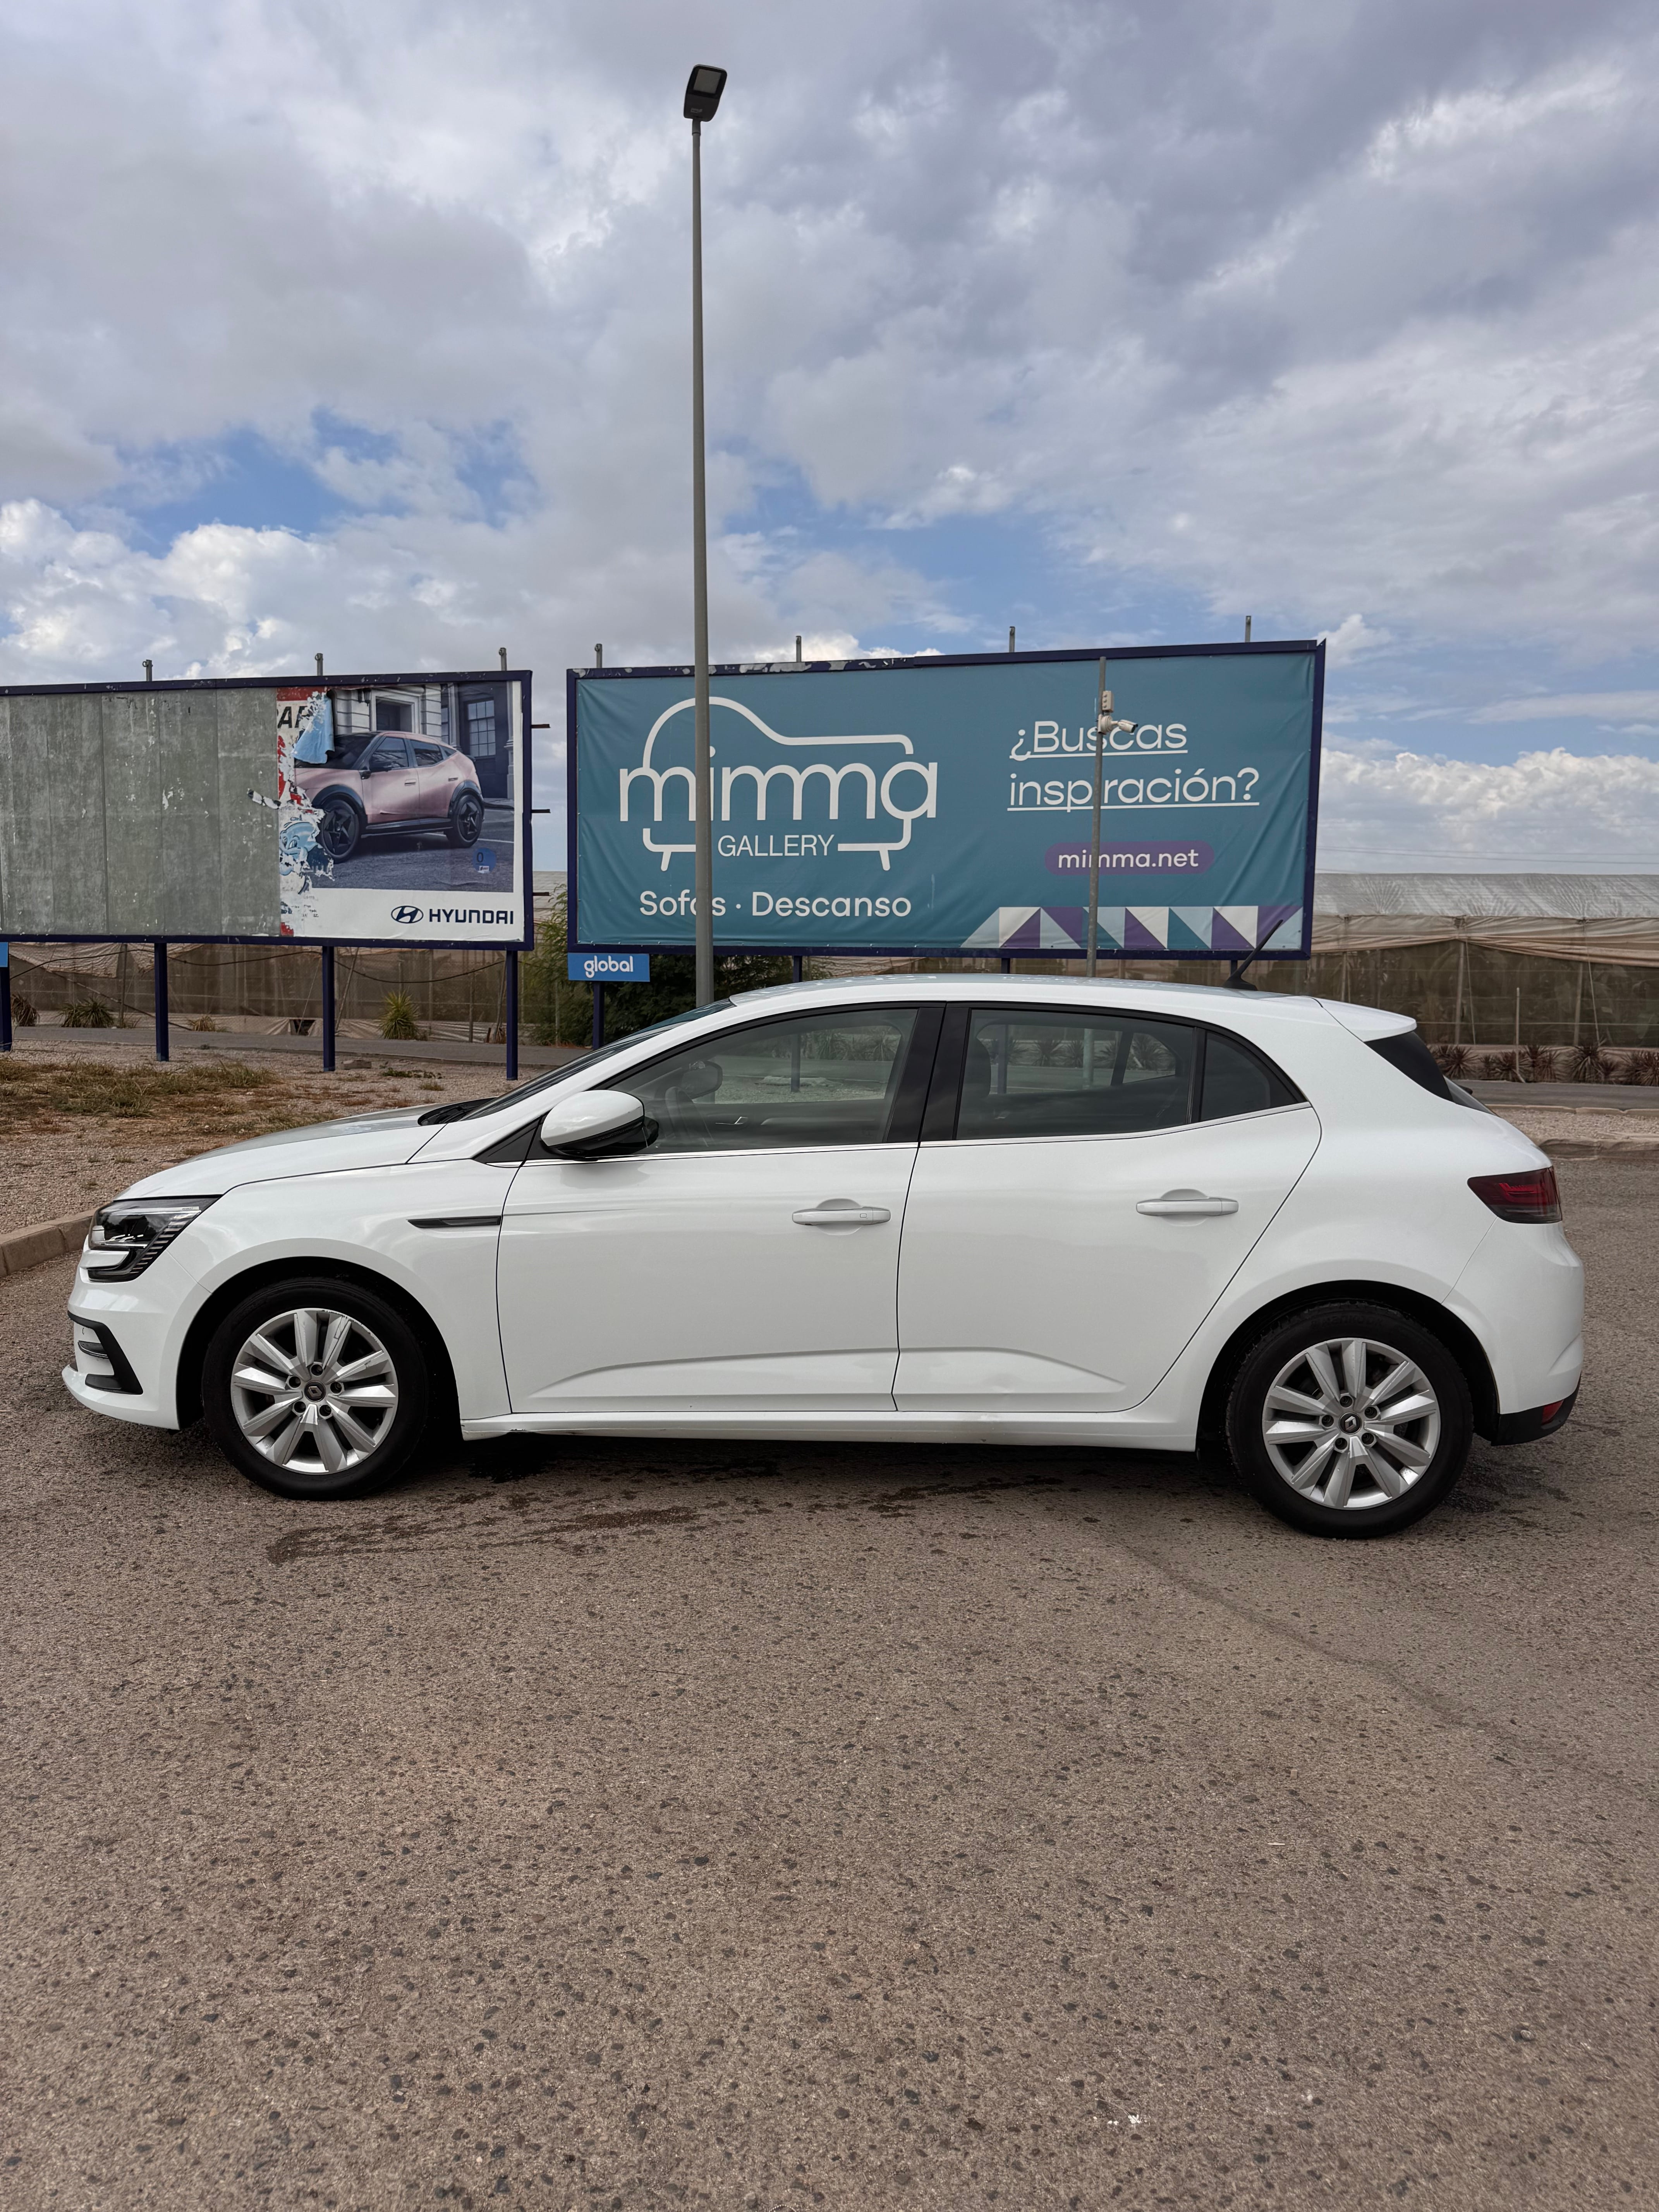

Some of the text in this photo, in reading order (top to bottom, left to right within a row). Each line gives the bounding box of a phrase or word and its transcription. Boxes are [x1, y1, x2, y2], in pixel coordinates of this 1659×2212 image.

[1010, 721, 1187, 761] ¿Buscas
[1010, 767, 1259, 812] inspración?
[718, 834, 835, 857] GALLERY
[1058, 849, 1199, 868] mimma.net
[752, 891, 912, 917] Descanso
[429, 908, 514, 924] HYUNDAI
[584, 955, 634, 978] global
